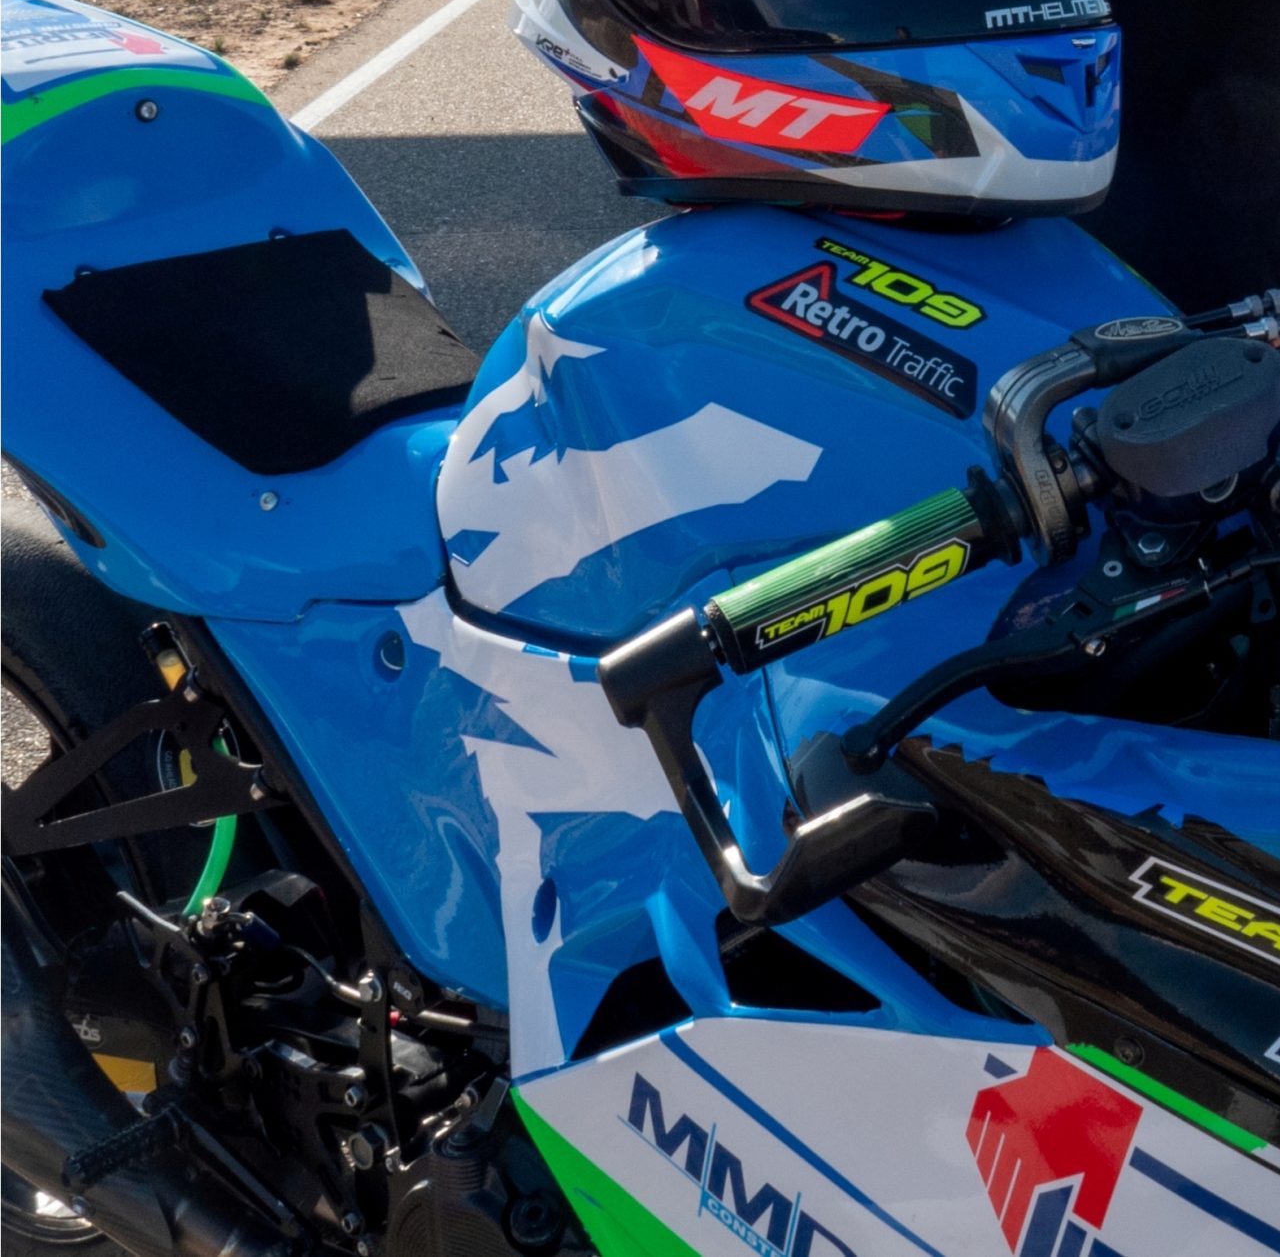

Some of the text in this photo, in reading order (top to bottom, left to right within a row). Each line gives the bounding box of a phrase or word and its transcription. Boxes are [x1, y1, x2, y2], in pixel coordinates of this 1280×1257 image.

[685, 76, 880, 140] MT
[821, 240, 984, 327] TEAM 109
[781, 282, 965, 399] Retro Traffic
[763, 544, 967, 641] TEAM 109
